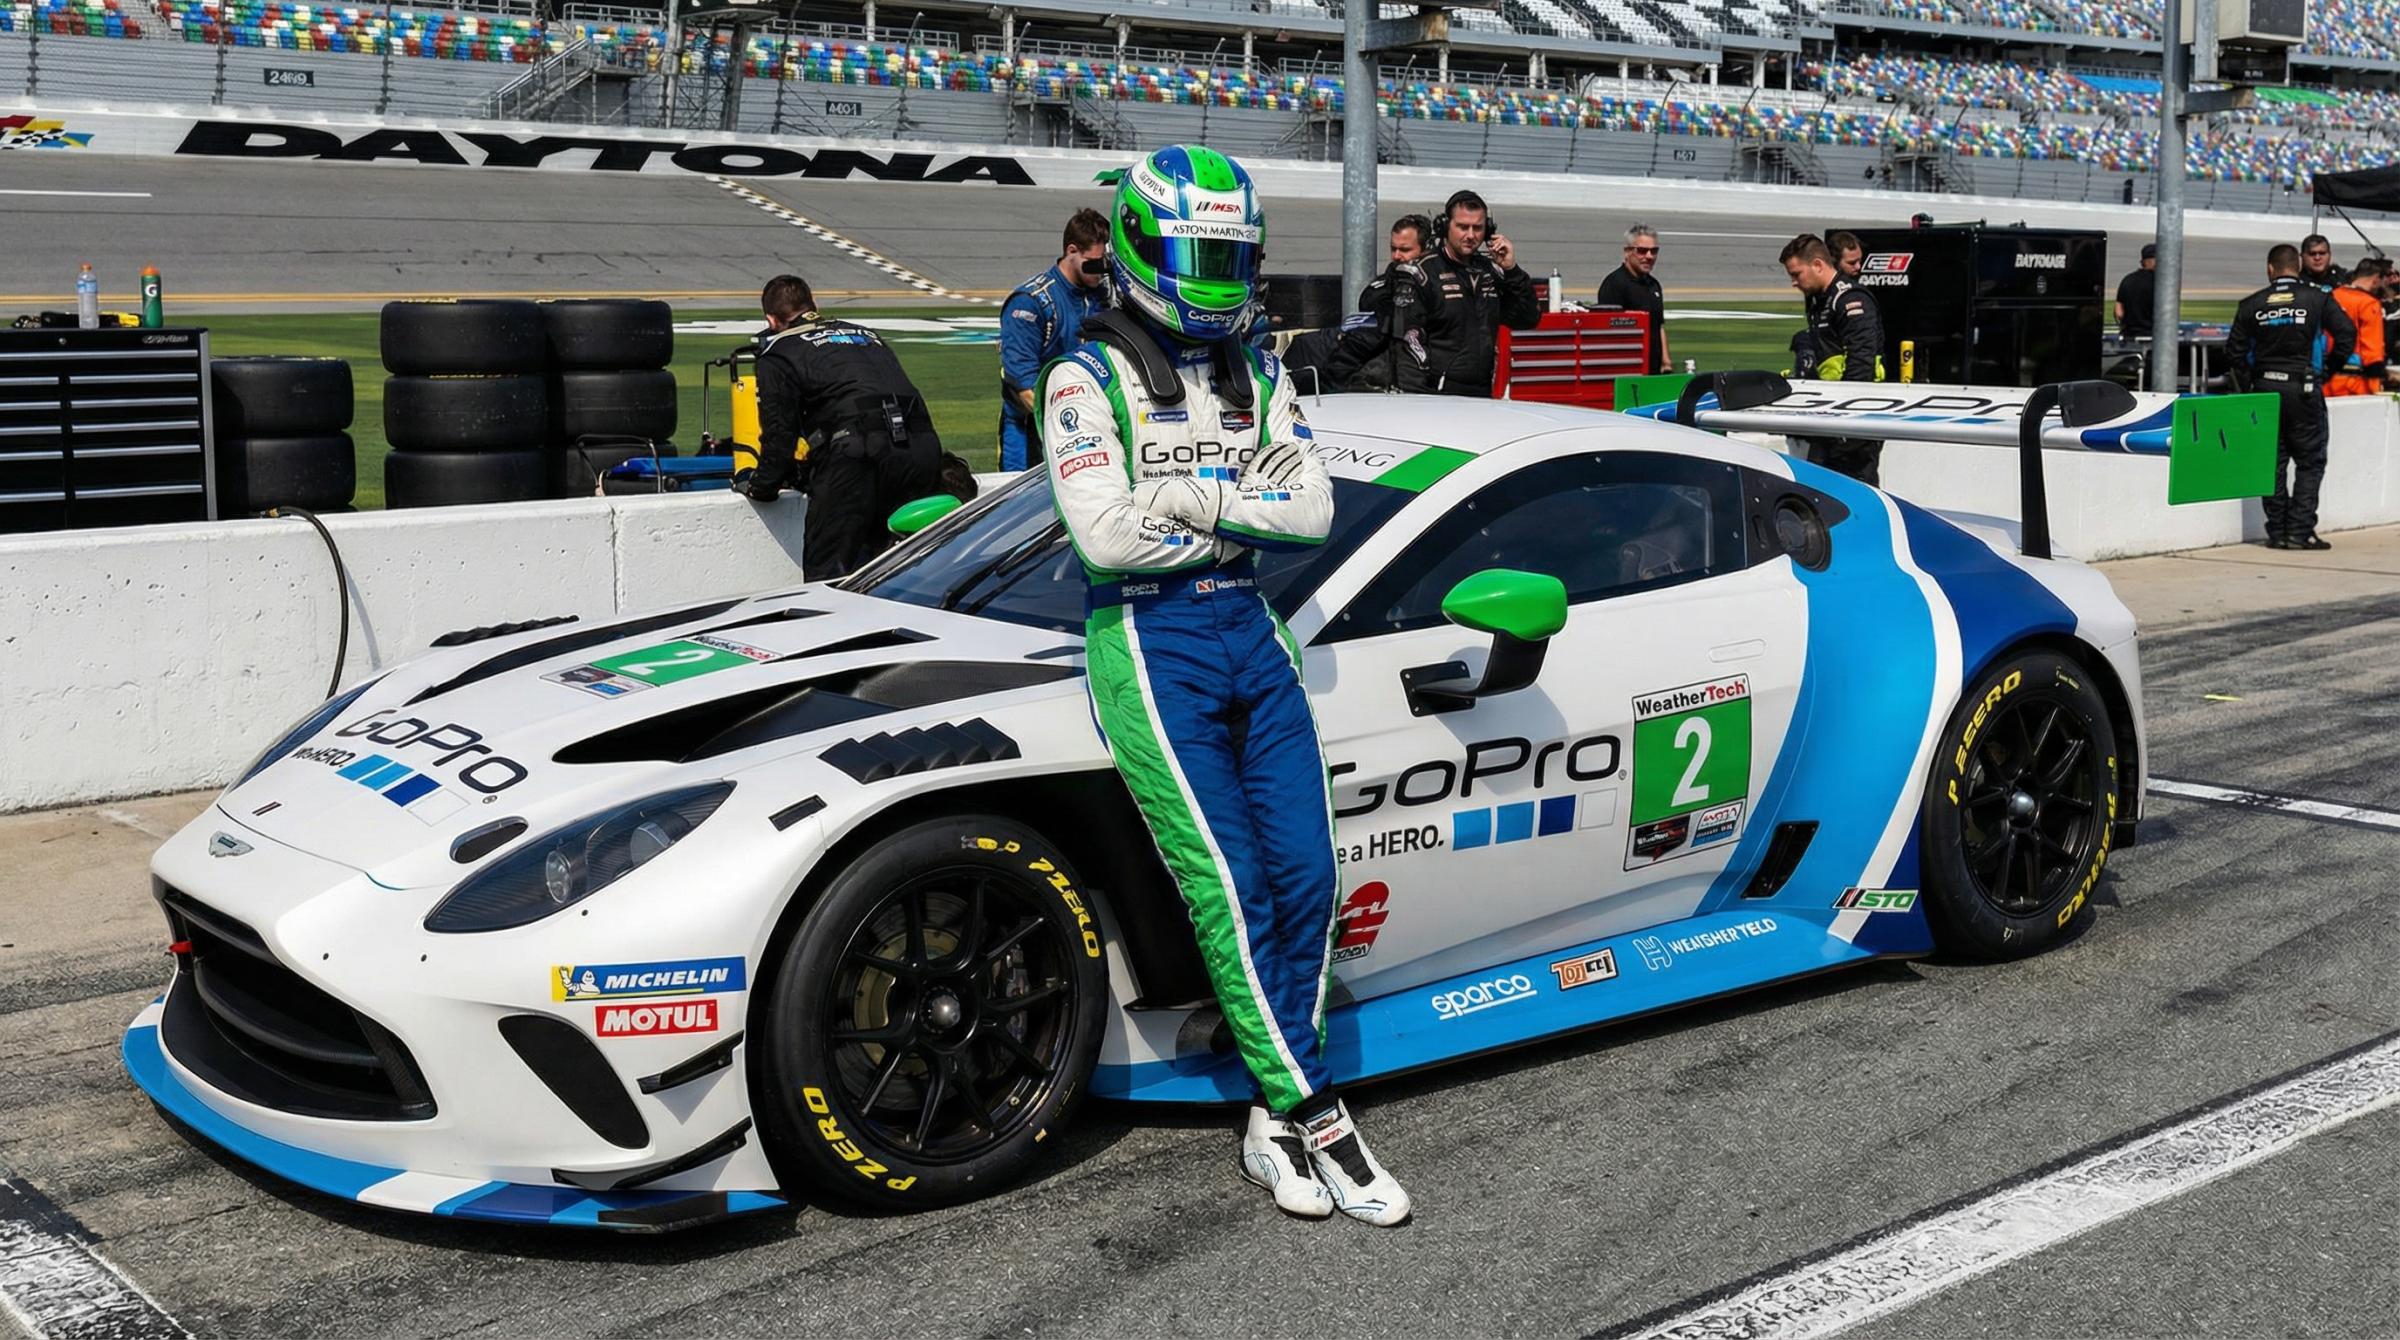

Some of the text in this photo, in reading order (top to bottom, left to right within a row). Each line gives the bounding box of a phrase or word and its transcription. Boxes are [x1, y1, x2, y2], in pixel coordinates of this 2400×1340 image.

[174, 119, 1037, 186] DAYTONA
[1172, 225, 1208, 236] ASTON
[1210, 226, 1245, 238] MARTIN
[145, 284, 157, 297] G
[2255, 308, 2307, 321] GoPro
[1055, 434, 1102, 456] GoPro
[1141, 441, 1256, 464] GoPro
[1061, 453, 1109, 478] MOTUL
[617, 649, 716, 676] 2
[1636, 679, 1746, 716] WeatherTech
[335, 709, 529, 794] GoPro
[1671, 716, 1713, 807] 2
[1331, 734, 1620, 818] GoPro
[1351, 845, 1363, 862] a
[1369, 824, 1445, 859] HERO.
[1858, 892, 1917, 908] STO
[604, 967, 729, 990] MICHELIN
[1431, 974, 1532, 1016] sparco
[602, 1004, 714, 1033] MOTUL
